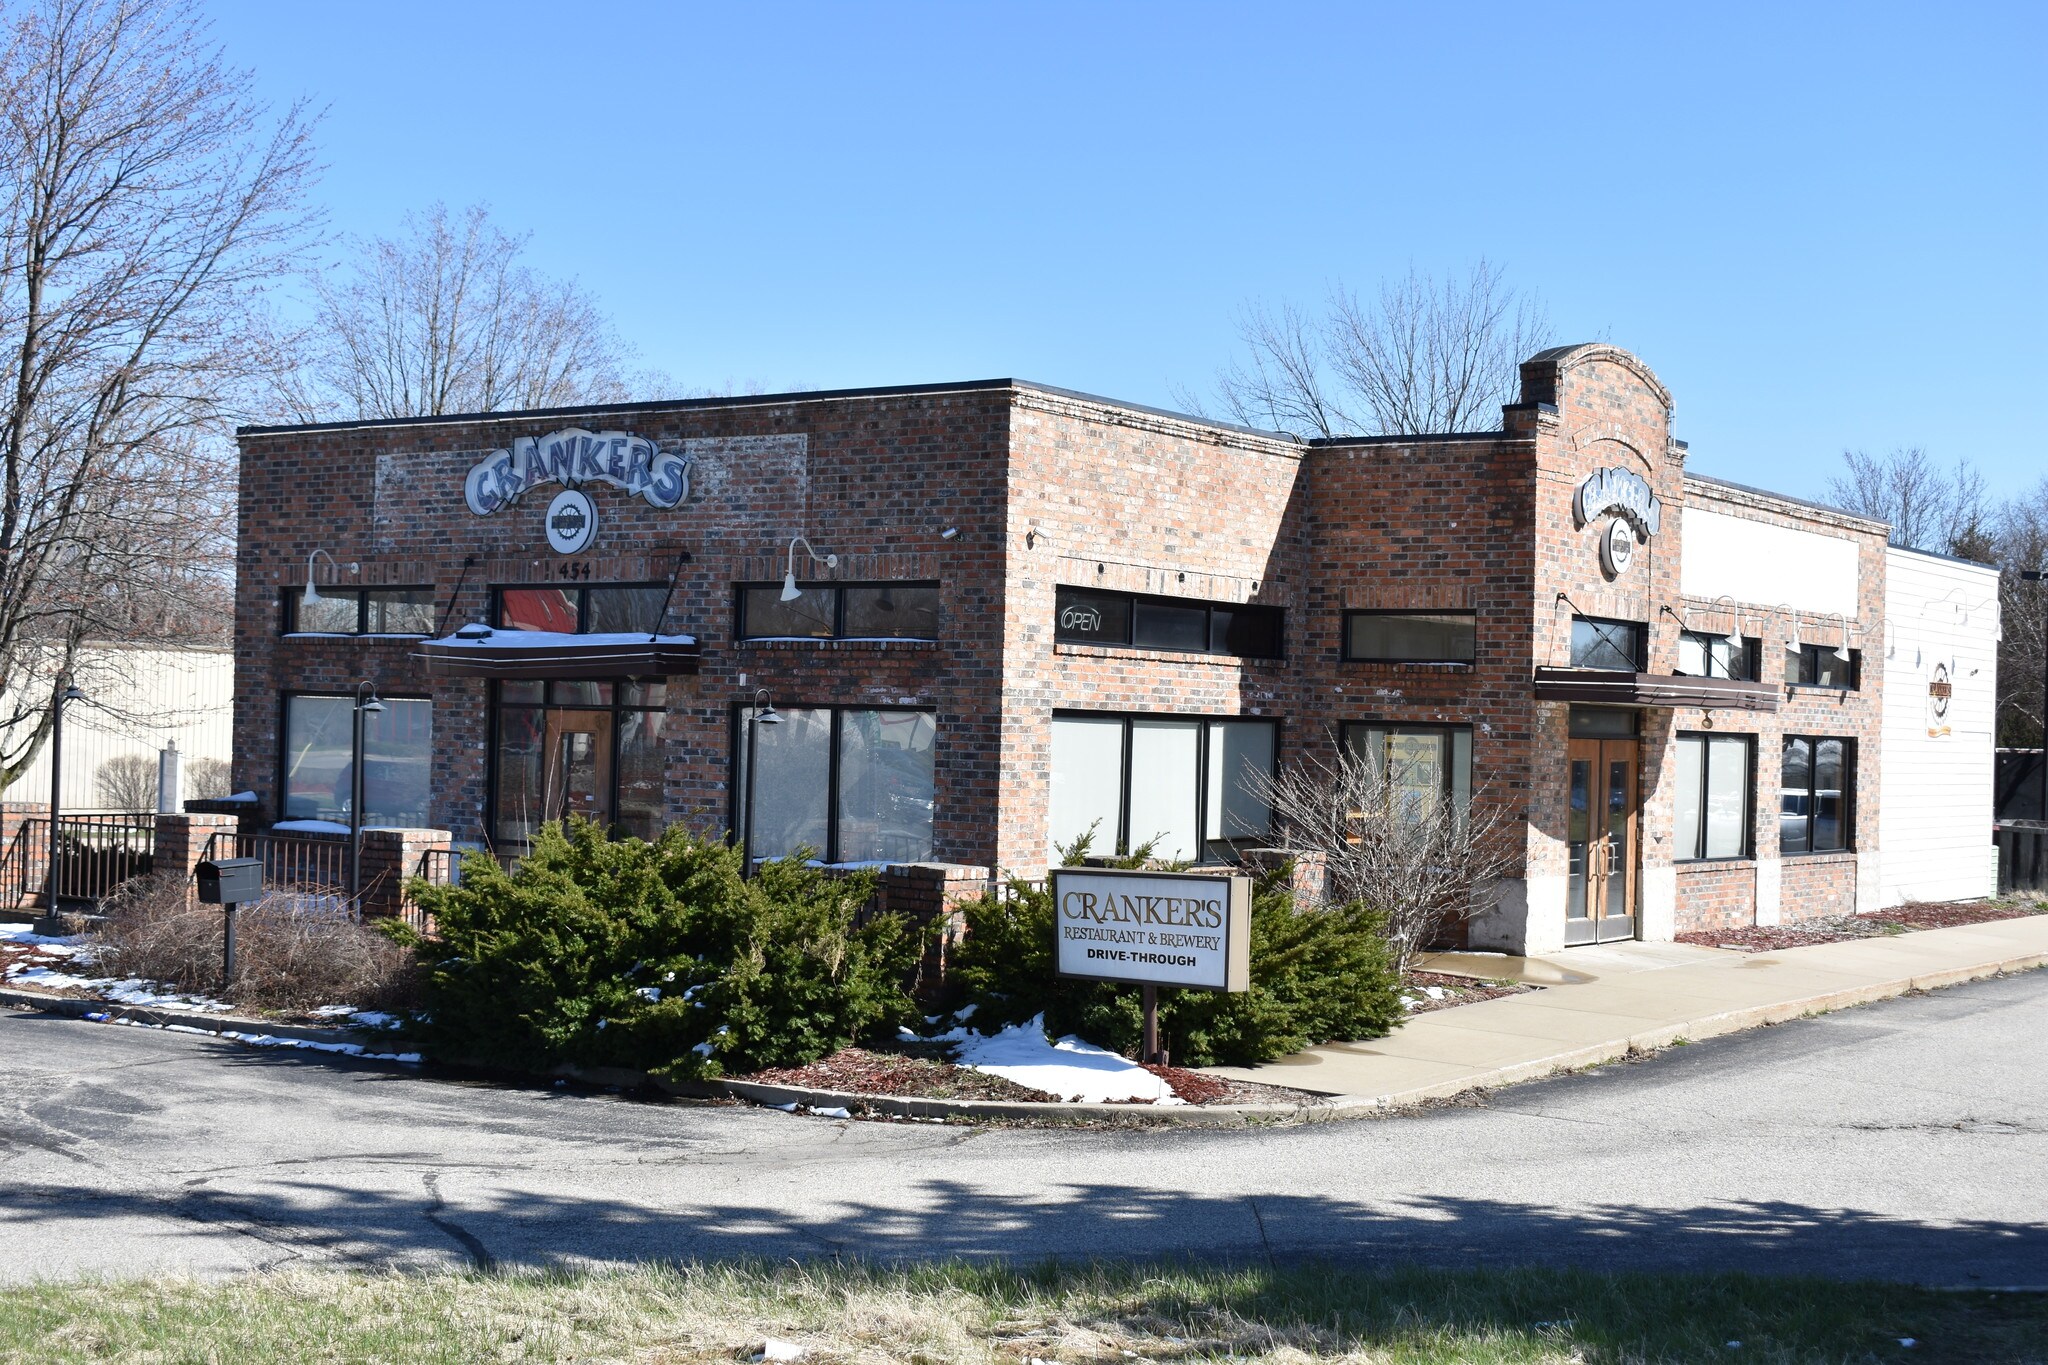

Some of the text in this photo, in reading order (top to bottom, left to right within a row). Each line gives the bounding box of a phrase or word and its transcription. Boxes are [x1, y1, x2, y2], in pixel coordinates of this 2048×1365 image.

[476, 436, 685, 511] CRANKERS
[559, 561, 591, 580] 454
[1063, 611, 1102, 631] OPEN
[1062, 891, 1222, 929] CRANKER'S
[1063, 926, 1221, 951] RESTAURANT & BREWERY
[1087, 948, 1197, 967] DRIVE-THROUGH
